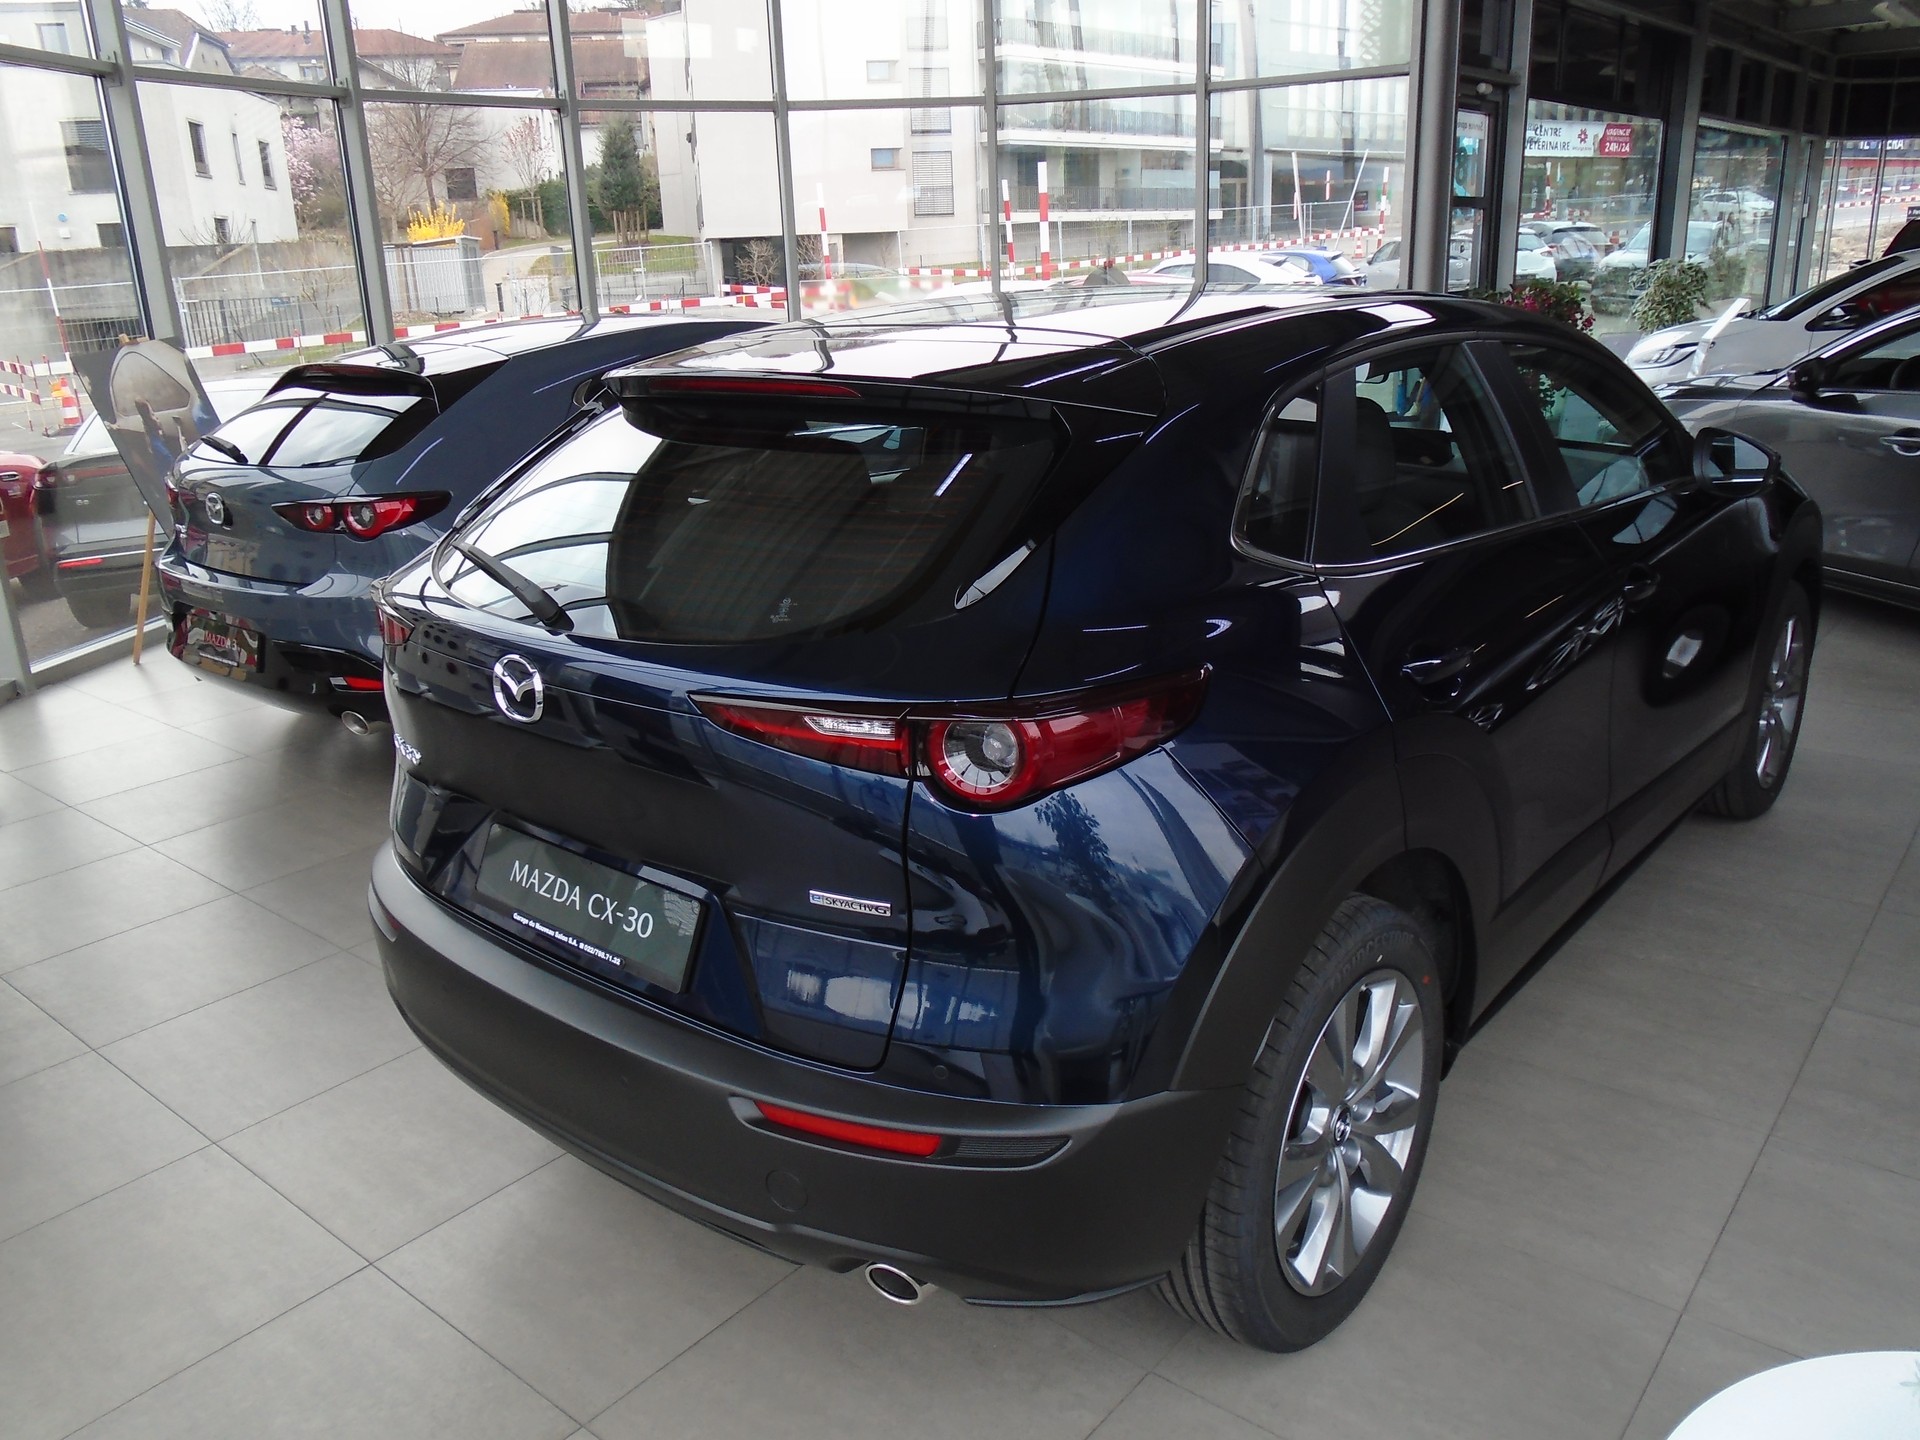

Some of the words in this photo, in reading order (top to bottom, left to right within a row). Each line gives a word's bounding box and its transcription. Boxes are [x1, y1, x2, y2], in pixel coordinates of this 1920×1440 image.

[1604, 142, 1630, 153] 24H/24
[509, 859, 581, 911] MAZDA
[587, 893, 655, 939] CX-30
